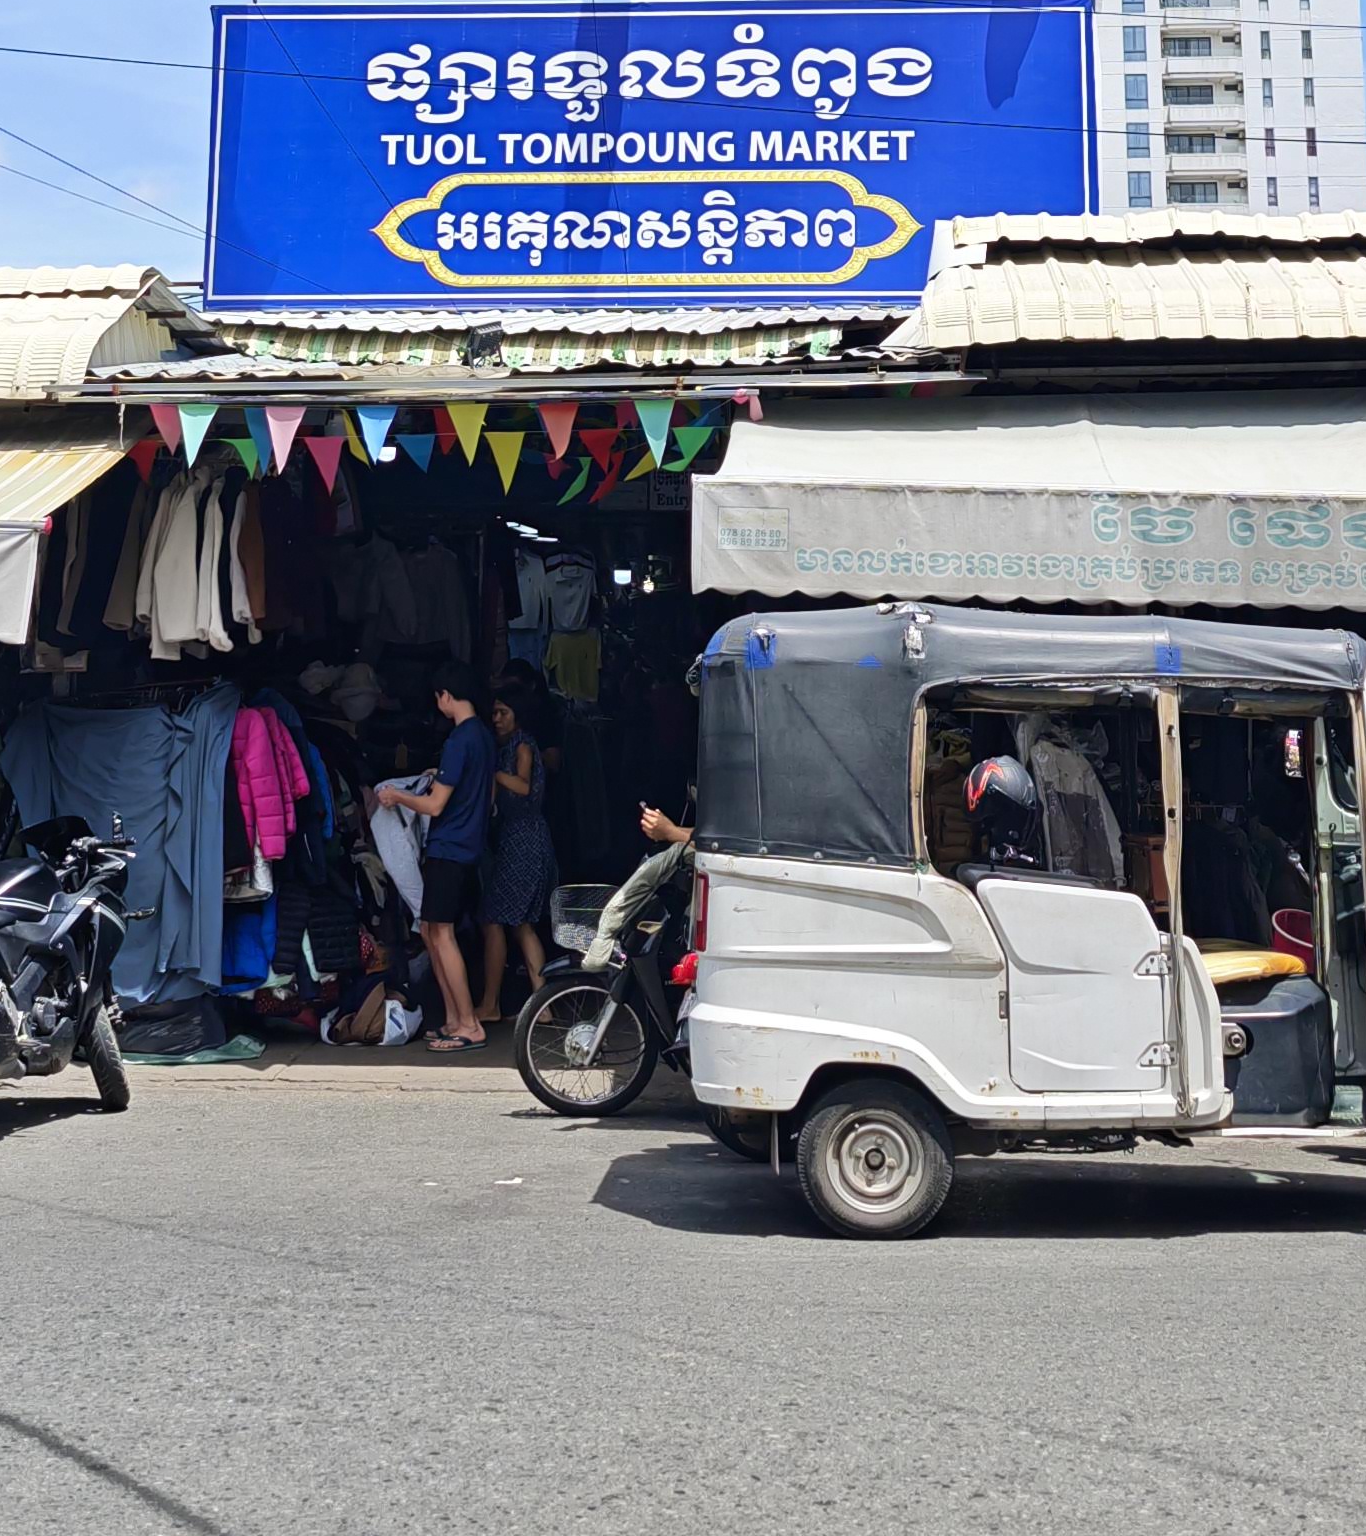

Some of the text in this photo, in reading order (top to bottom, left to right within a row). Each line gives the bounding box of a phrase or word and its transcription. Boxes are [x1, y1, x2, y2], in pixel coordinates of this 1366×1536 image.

[367, 22, 933, 124] ផ្សារទួលទំពូង
[381, 129, 915, 165] TUOL TOMPOUNG MARKET
[720, 528, 738, 537] 078
[740, 528, 752, 537] 82
